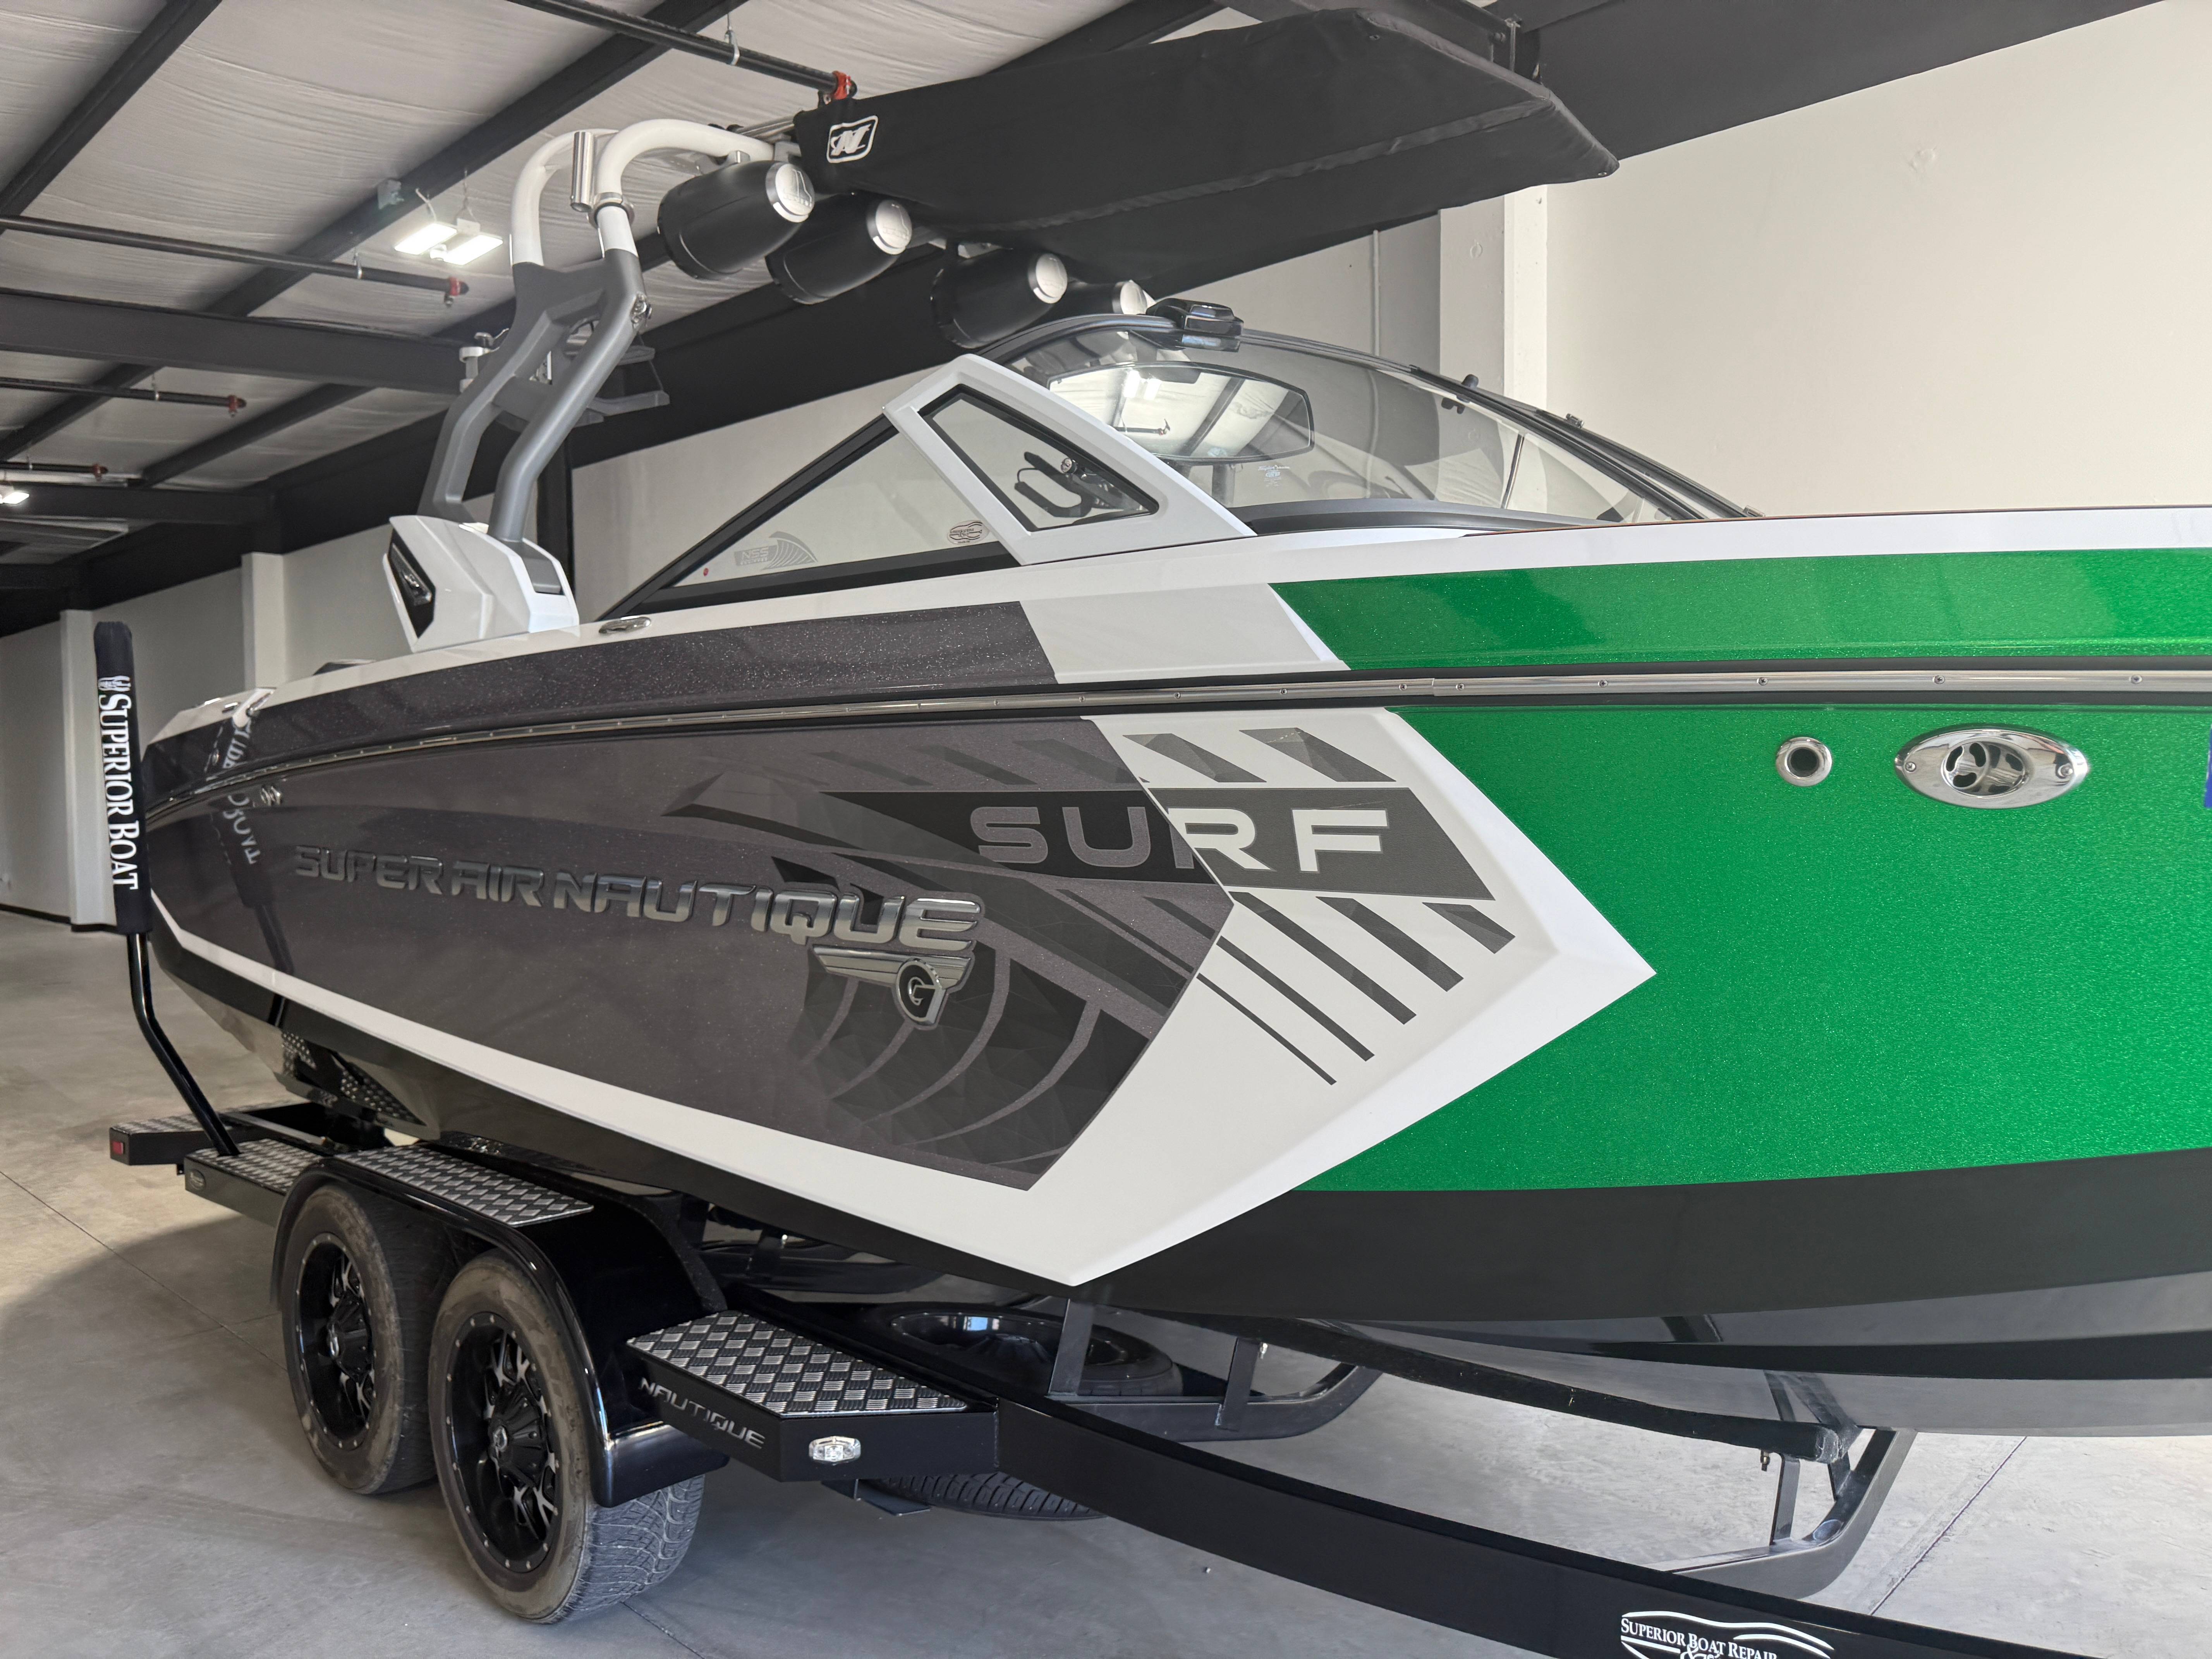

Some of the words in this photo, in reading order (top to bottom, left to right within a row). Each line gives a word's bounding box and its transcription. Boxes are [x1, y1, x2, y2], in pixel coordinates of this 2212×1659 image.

[98, 694, 134, 816] SUPERIOR
[109, 820, 140, 890] BOAT
[970, 805, 1389, 873] SURF
[294, 845, 443, 895] SUPER
[451, 861, 544, 907] AIR
[553, 870, 985, 951] NAUTIQUE
[639, 1377, 765, 1449] NAUTIQUE
[1621, 1618, 1686, 1647] SUPERIOR
[1688, 1633, 1726, 1655] BOAT
[1728, 1642, 1777, 1659] REPAIR
